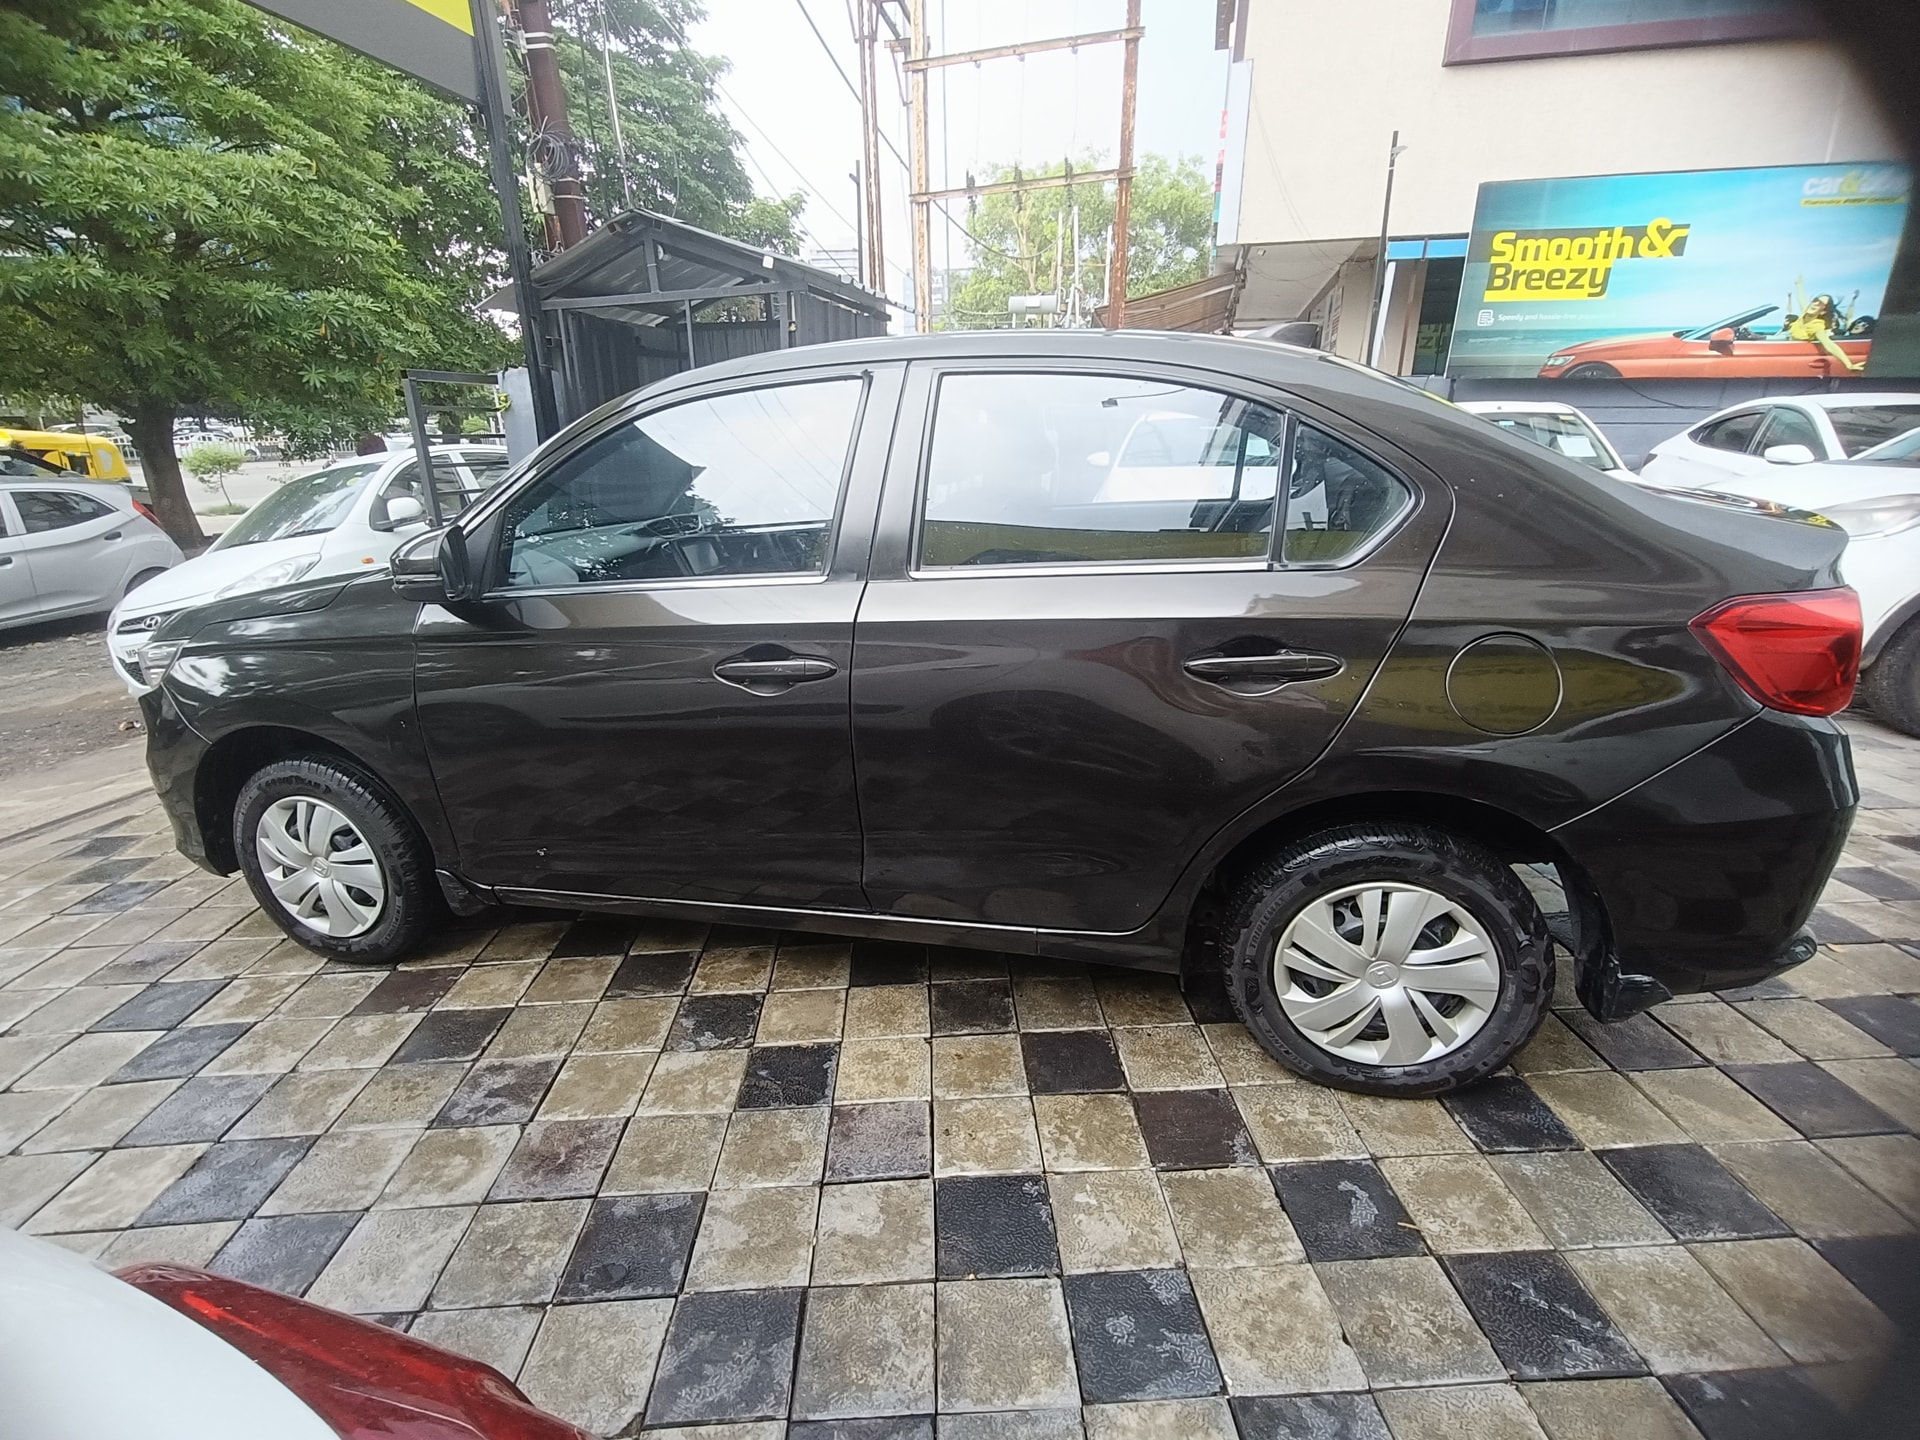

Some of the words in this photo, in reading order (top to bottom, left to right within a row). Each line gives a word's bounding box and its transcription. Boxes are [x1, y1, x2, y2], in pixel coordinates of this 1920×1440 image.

[1490, 226, 1634, 264] Smooth
[1637, 217, 1690, 258] &
[1486, 262, 1612, 297] Breezy
[1498, 314, 1523, 322] Speedy
